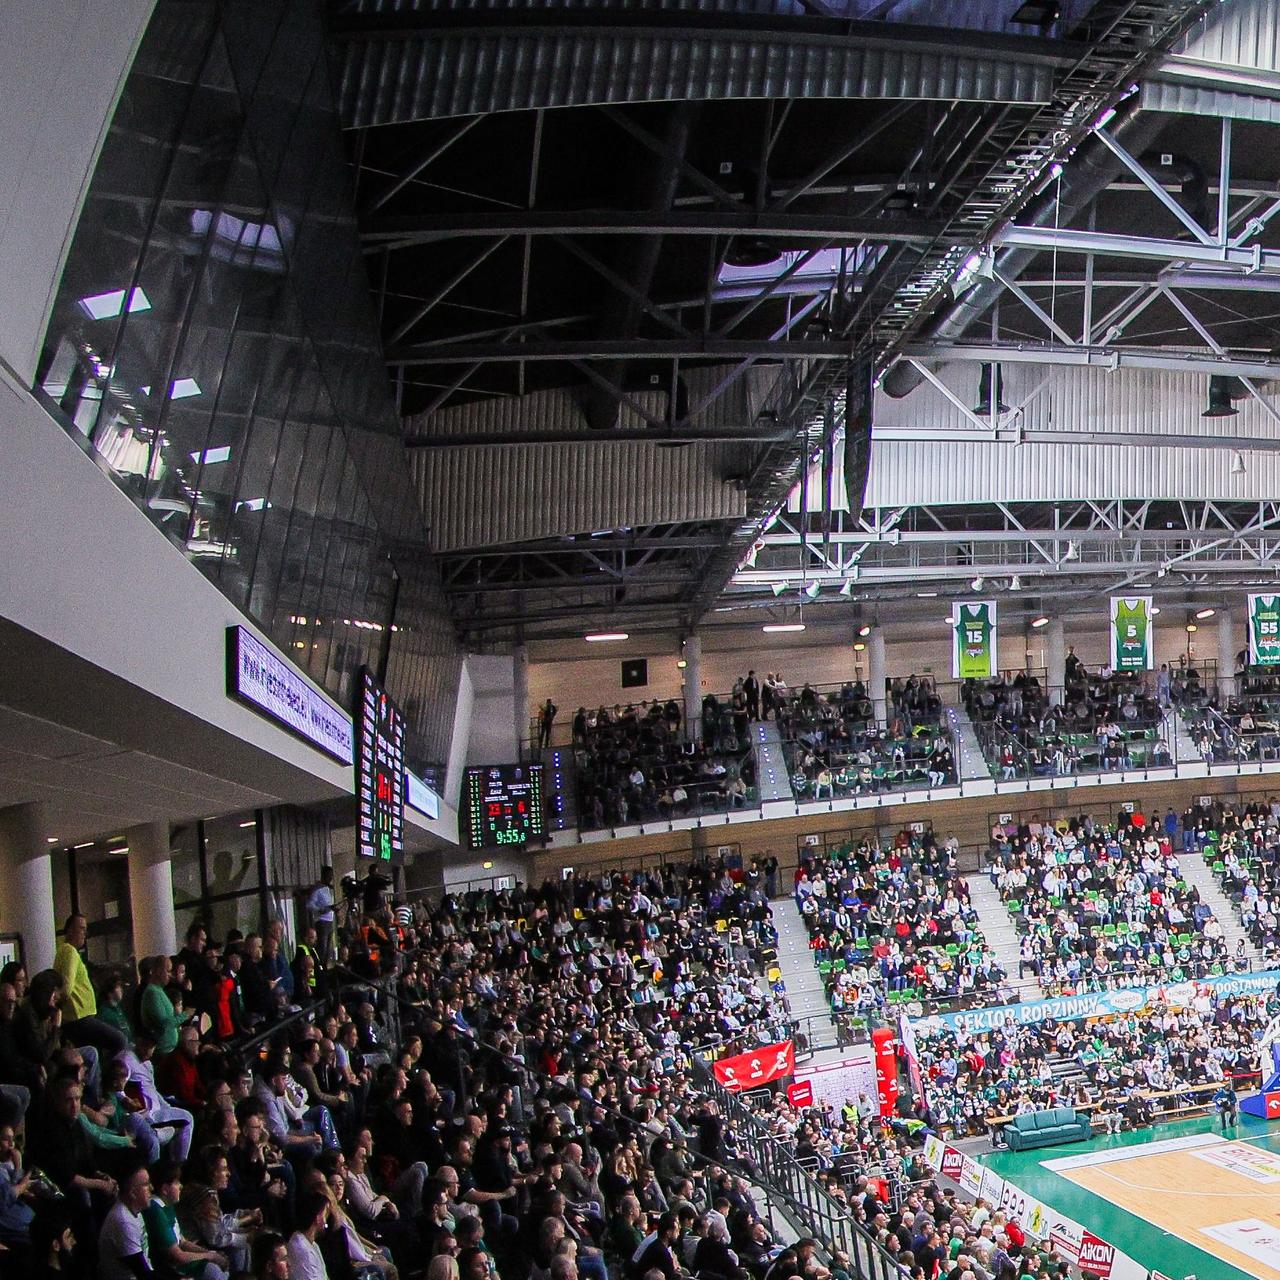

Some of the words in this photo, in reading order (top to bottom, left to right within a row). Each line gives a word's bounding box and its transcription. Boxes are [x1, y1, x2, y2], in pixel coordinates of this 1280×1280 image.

[1127, 624, 1137, 637] 5
[1260, 621, 1279, 634] 55
[965, 630, 983, 643] 15
[1216, 976, 1276, 994] DOSTAWCA
[955, 1008, 1016, 1032] SEKTOR
[1020, 996, 1100, 1023] RODZINNY
[1079, 1243, 1113, 1264] AiKON
